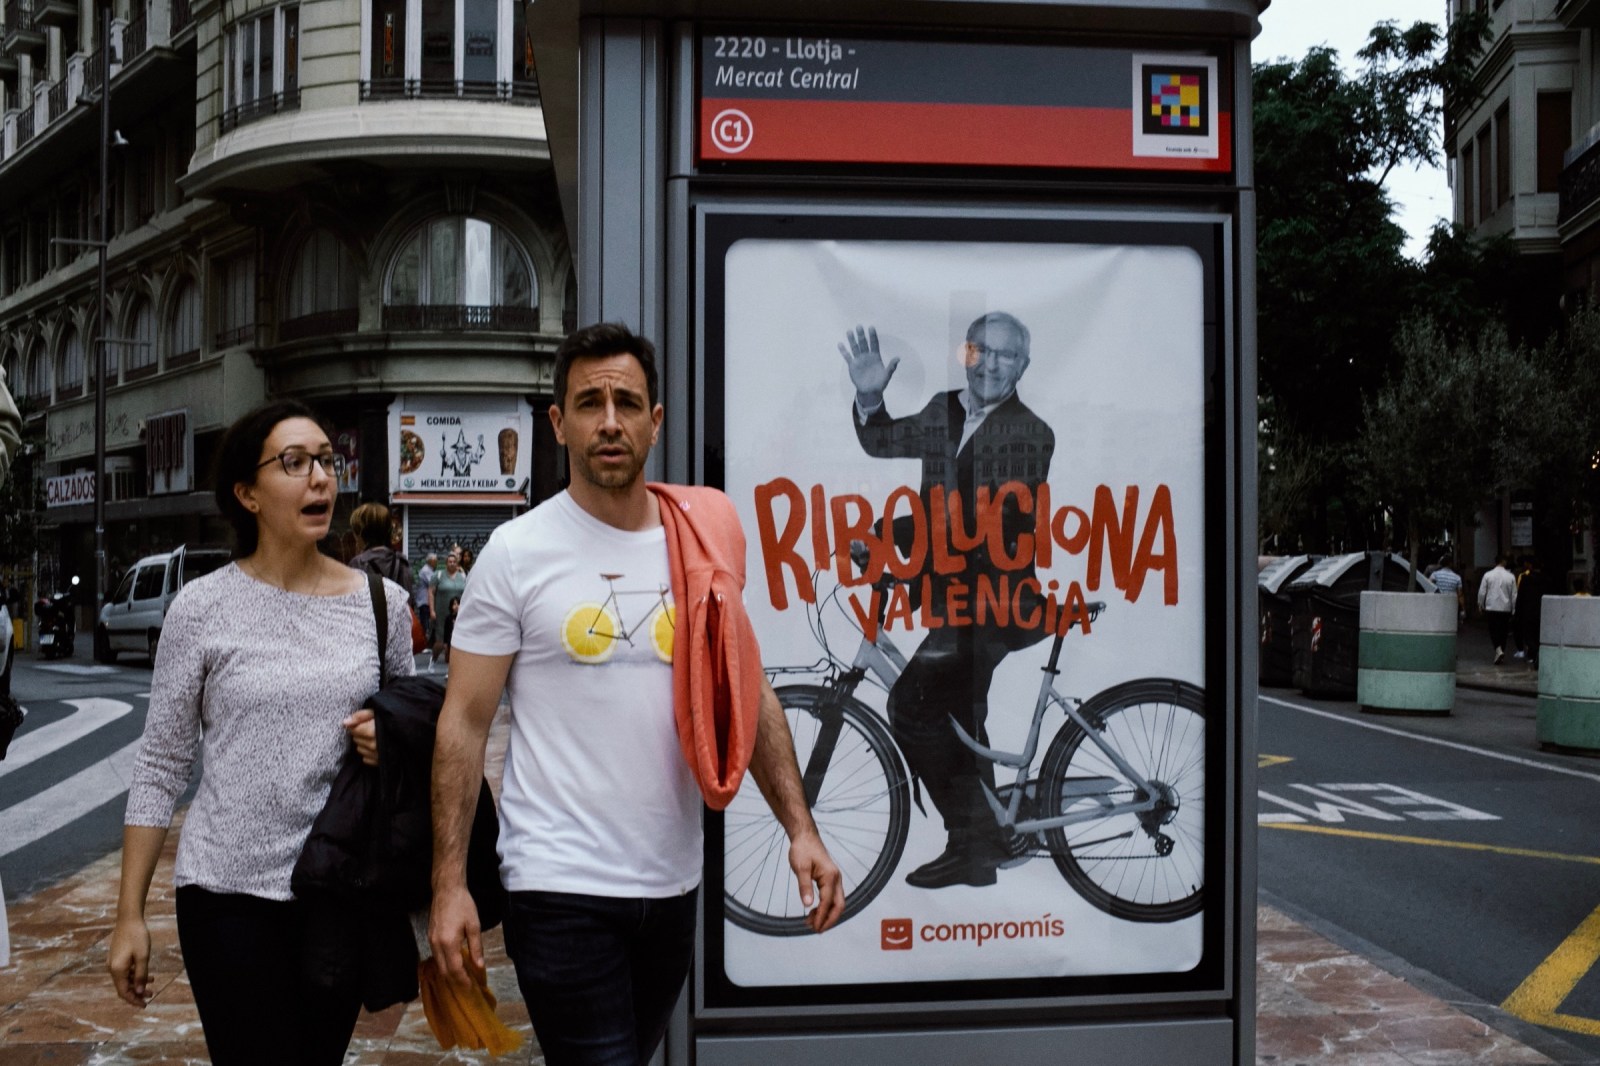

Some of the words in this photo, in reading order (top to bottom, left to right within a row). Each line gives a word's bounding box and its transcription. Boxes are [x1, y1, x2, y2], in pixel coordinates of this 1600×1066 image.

[715, 36, 767, 59] 2220
[786, 37, 843, 65] Llotja
[716, 65, 785, 88] Mercat
[790, 66, 860, 90] Central
[719, 120, 743, 142] C1
[427, 416, 461, 426] COMIDA
[48, 475, 95, 504] CALZADOS
[421, 478, 451, 488] MERLIN'S
[452, 478, 470, 488] PIZZA
[471, 478, 477, 488] Y
[477, 478, 498, 488] KEBAP
[920, 913, 1064, 947] compromís
